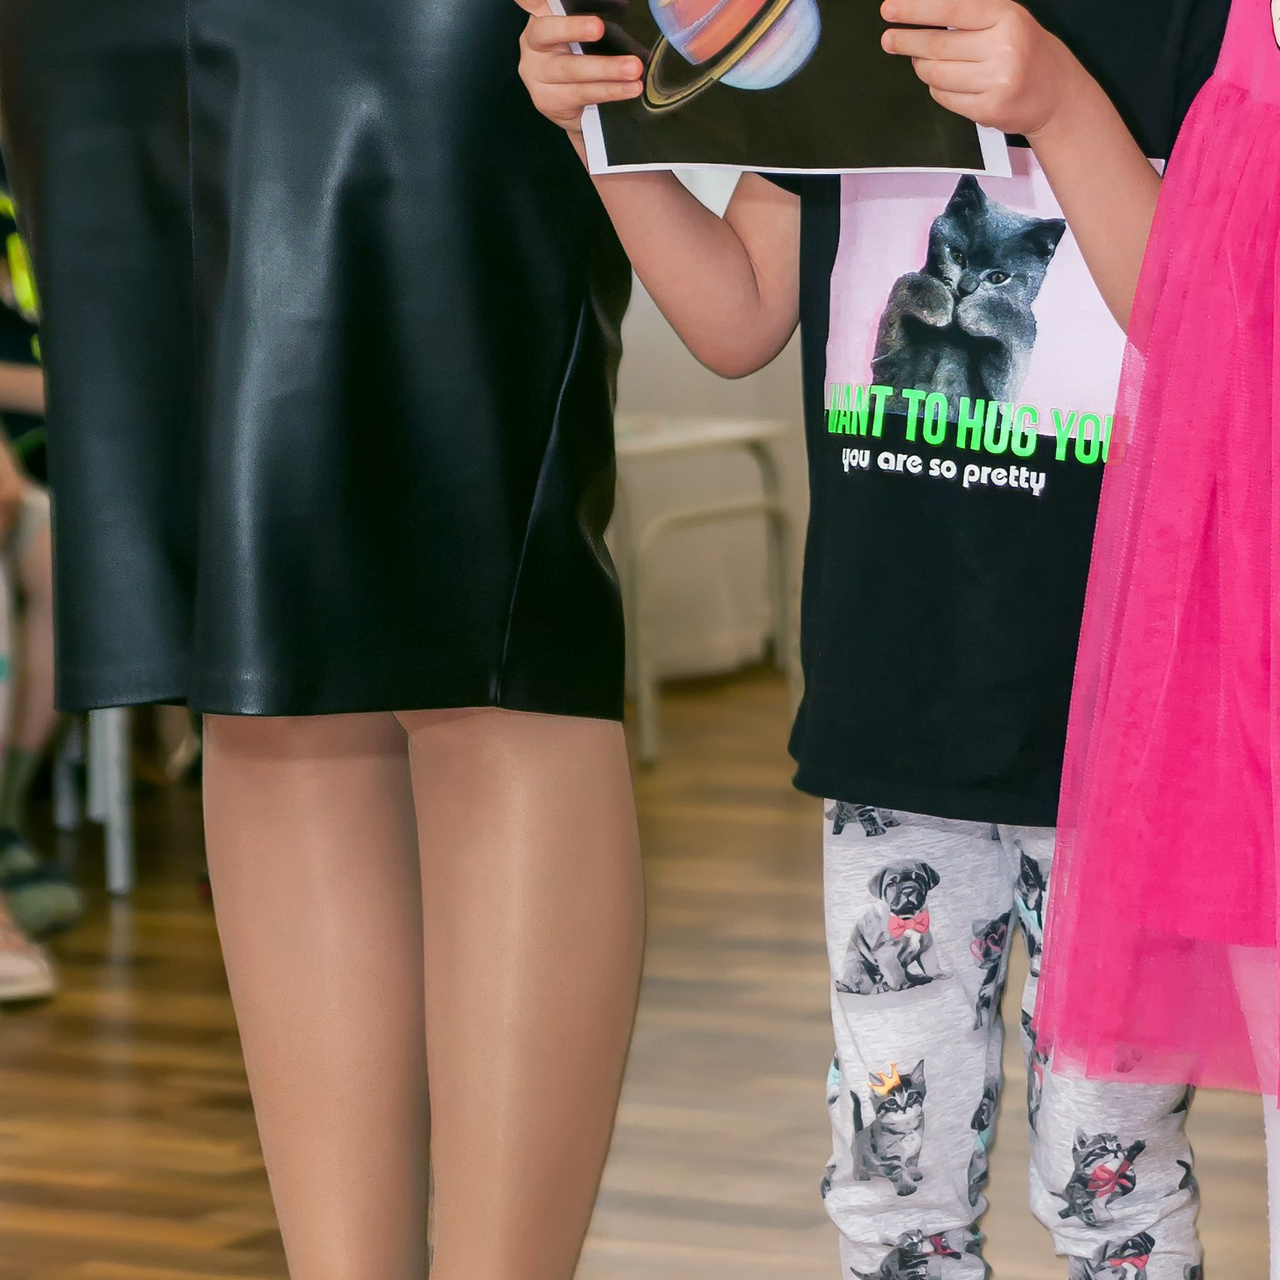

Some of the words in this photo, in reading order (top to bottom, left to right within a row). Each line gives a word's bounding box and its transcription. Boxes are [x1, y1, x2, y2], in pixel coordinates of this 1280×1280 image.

[902, 388, 947, 446] TO
[956, 396, 1039, 458] HUG
[842, 448, 870, 473] you
[877, 451, 923, 474] are
[928, 458, 957, 479] so
[962, 464, 1046, 497] pretty
